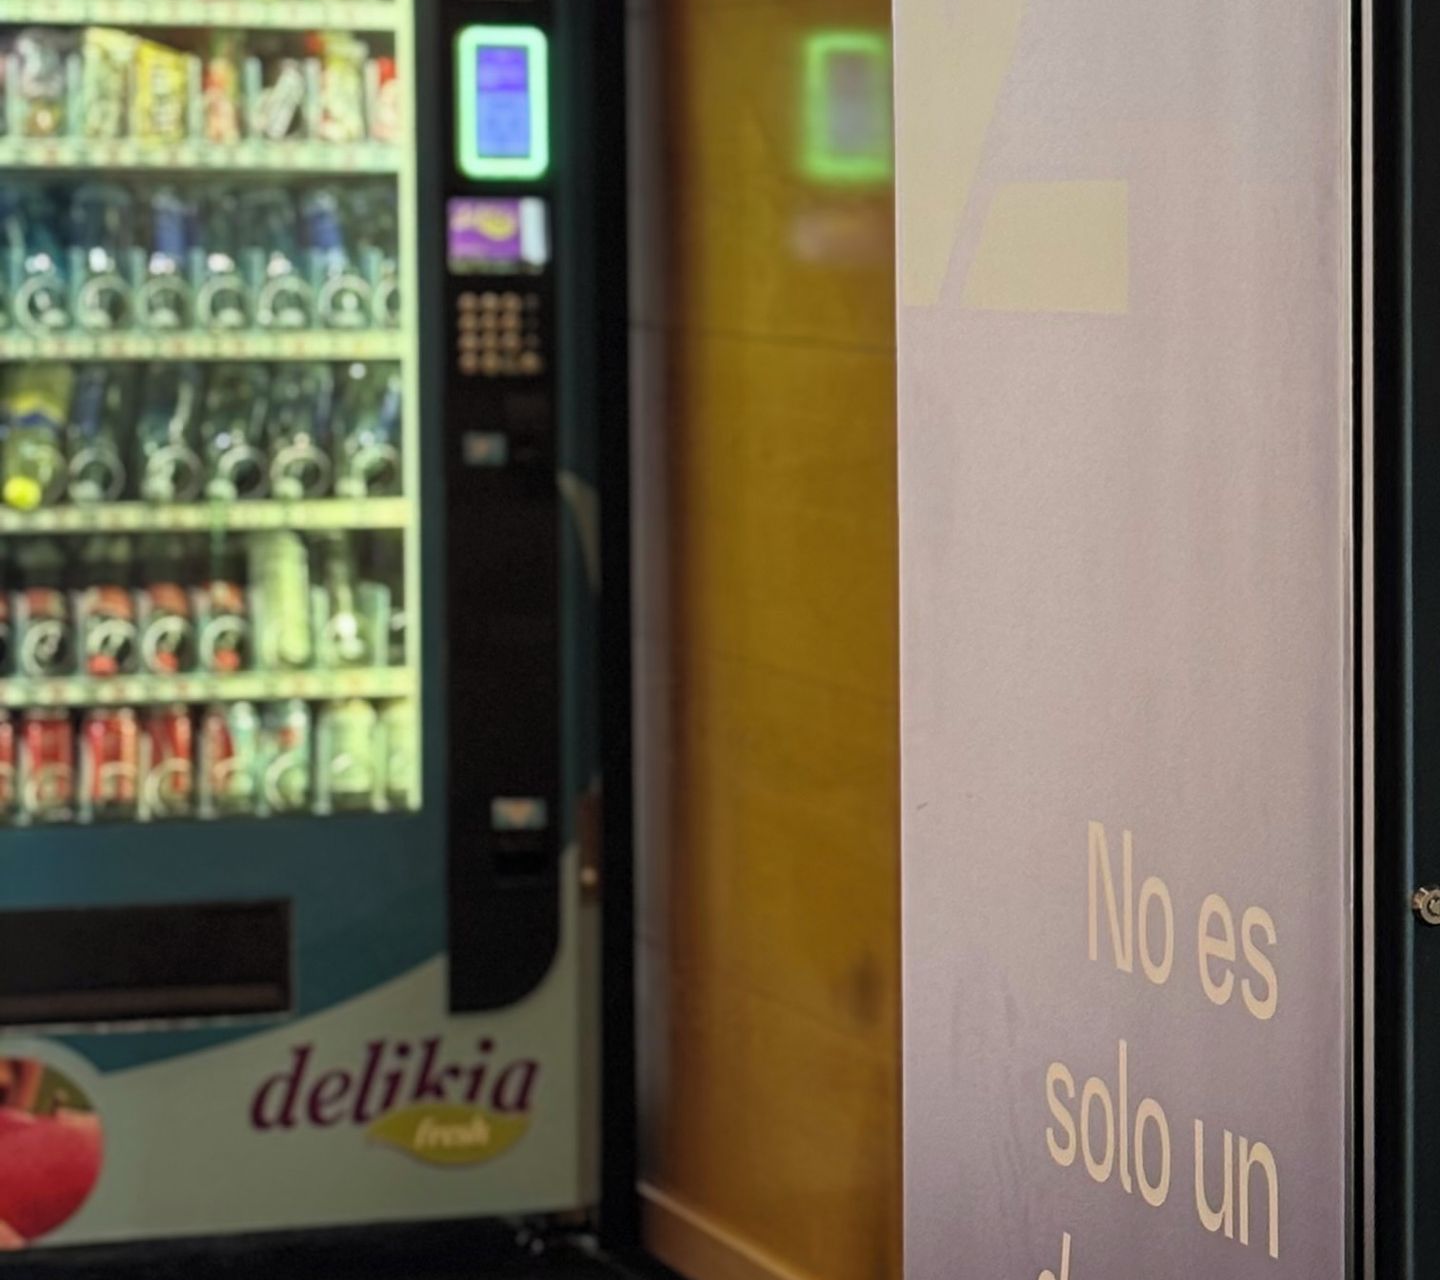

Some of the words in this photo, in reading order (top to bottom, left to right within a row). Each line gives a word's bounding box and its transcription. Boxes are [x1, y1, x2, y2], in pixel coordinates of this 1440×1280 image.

[1085, 820, 1175, 988] No
[1198, 891, 1278, 1020] es
[249, 1036, 541, 1133] delikia
[414, 1113, 491, 1151] fresh
[1045, 1039, 1173, 1209] solo
[1193, 1117, 1279, 1258] un
